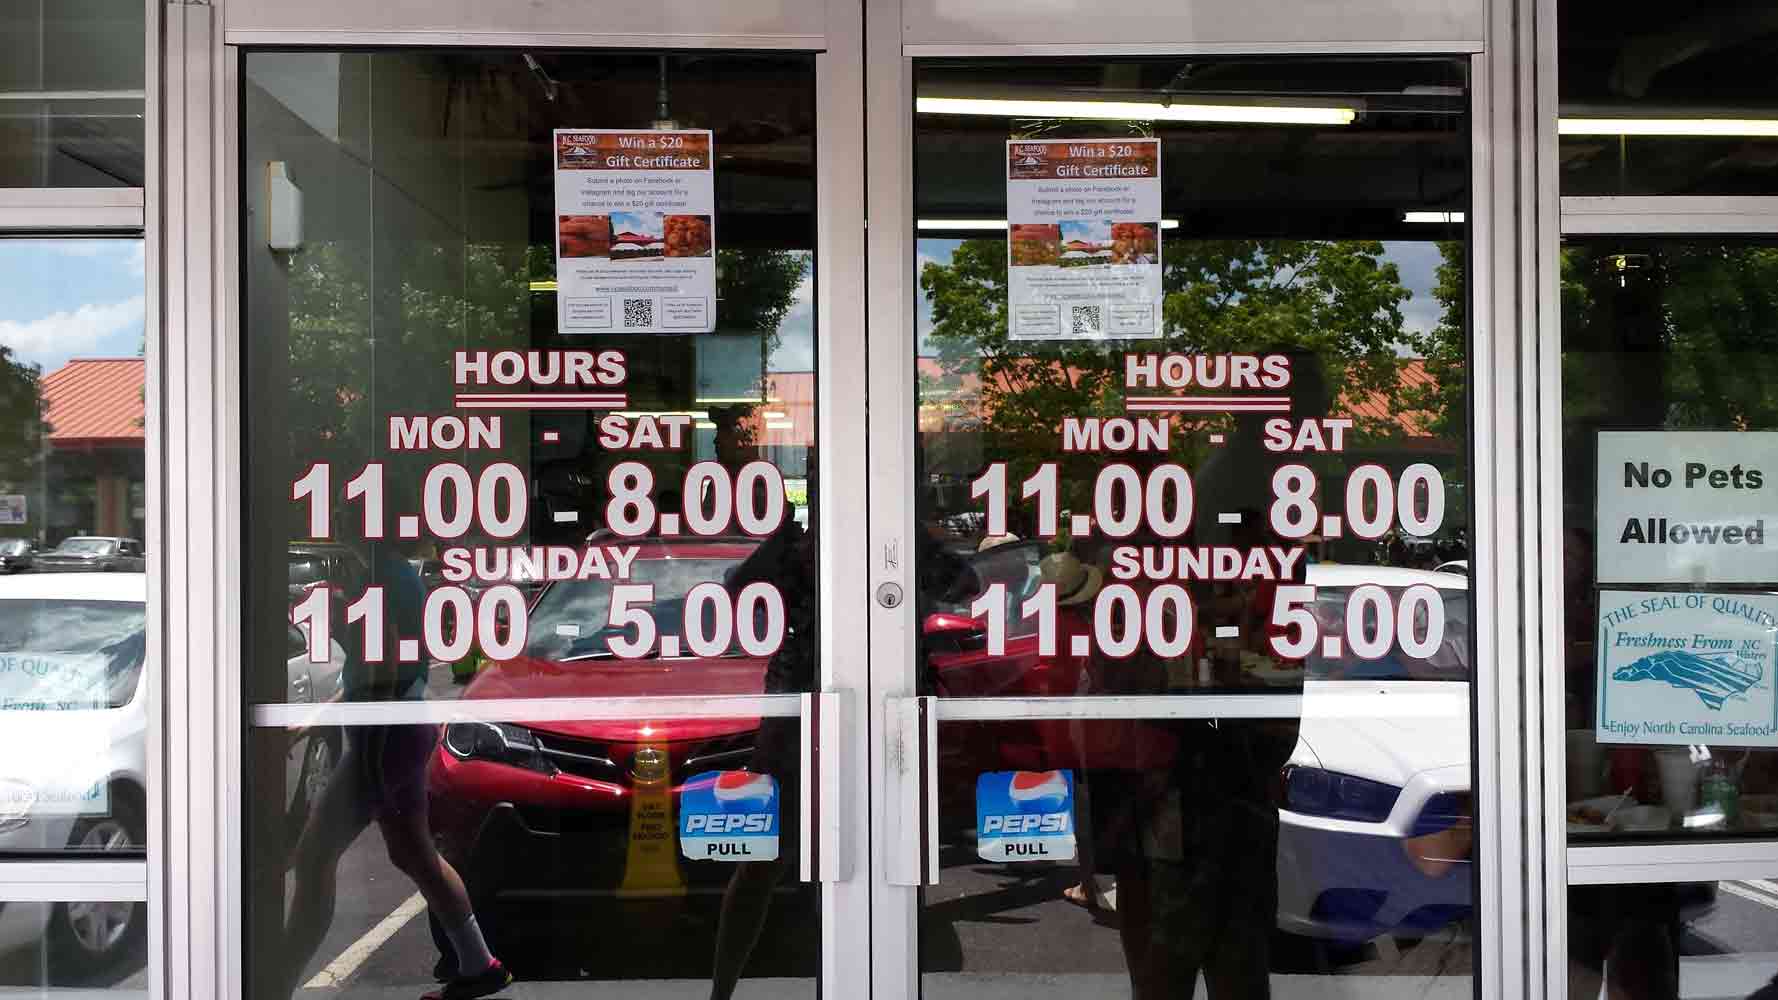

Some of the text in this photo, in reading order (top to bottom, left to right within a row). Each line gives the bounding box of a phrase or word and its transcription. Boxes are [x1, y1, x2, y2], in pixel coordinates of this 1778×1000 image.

[619, 136, 683, 149] Win a $20
[1069, 145, 1132, 158] Win a $20
[606, 155, 630, 168] Gift
[634, 155, 700, 168] Certificate
[1056, 164, 1080, 176] Gift
[1083, 164, 1149, 176] Certificate
[454, 350, 627, 386] HOURS
[1125, 354, 1291, 389] HOURS
[389, 414, 691, 450] MON - SAT
[1062, 417, 1353, 452] MON - SAT
[1623, 461, 1764, 489] No Pets
[291, 460, 786, 540] 11.00 - 8.00
[970, 462, 1446, 540] 11.00 - 8.00
[1619, 517, 1764, 545] Allowed
[441, 545, 641, 582] SUNDAY
[1111, 546, 1305, 580] SUNDAY
[291, 582, 786, 663] 11.00 - 5.00
[970, 583, 1446, 660] 11.00 - 5.00
[1603, 605, 1638, 628] THE
[1641, 596, 1680, 614] SEAL
[1686, 595, 1707, 609] OF
[1616, 632, 1760, 650] Freshness From NC
[1610, 721, 1770, 736] Enjoy North Carolina Seafood
[686, 814, 772, 833] PEPSI
[984, 814, 1069, 833] PEPSI
[707, 844, 751, 855] PULL
[1005, 844, 1048, 855] PULL
